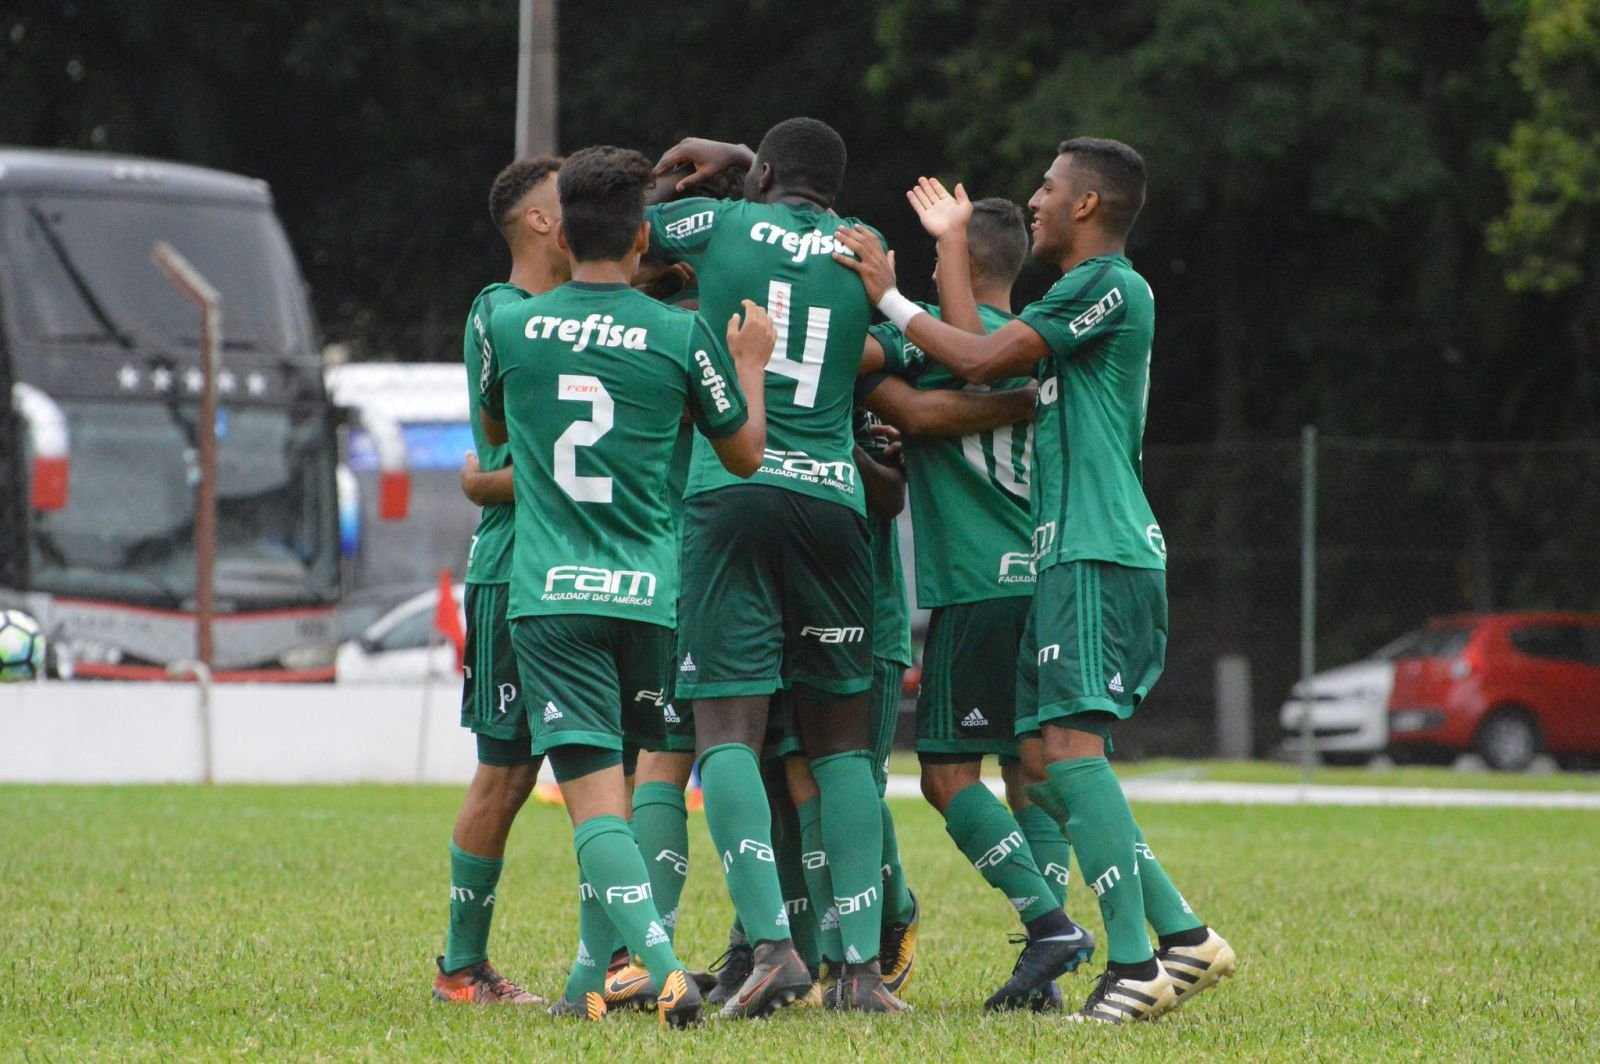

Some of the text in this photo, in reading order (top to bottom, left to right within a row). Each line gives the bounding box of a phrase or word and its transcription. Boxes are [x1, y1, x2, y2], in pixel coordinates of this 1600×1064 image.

[524, 313, 648, 352] crefisa
[764, 280, 831, 408] 4
[695, 350, 731, 413] crefisa
[554, 374, 614, 503] 2
[758, 466, 798, 479] CULDADE
[800, 474, 819, 483] DAS
[998, 575, 1037, 584] FACULDA
[541, 592, 590, 601] FACULDADE
[592, 593, 610, 602] DAS
[961, 718, 988, 727] adidas
